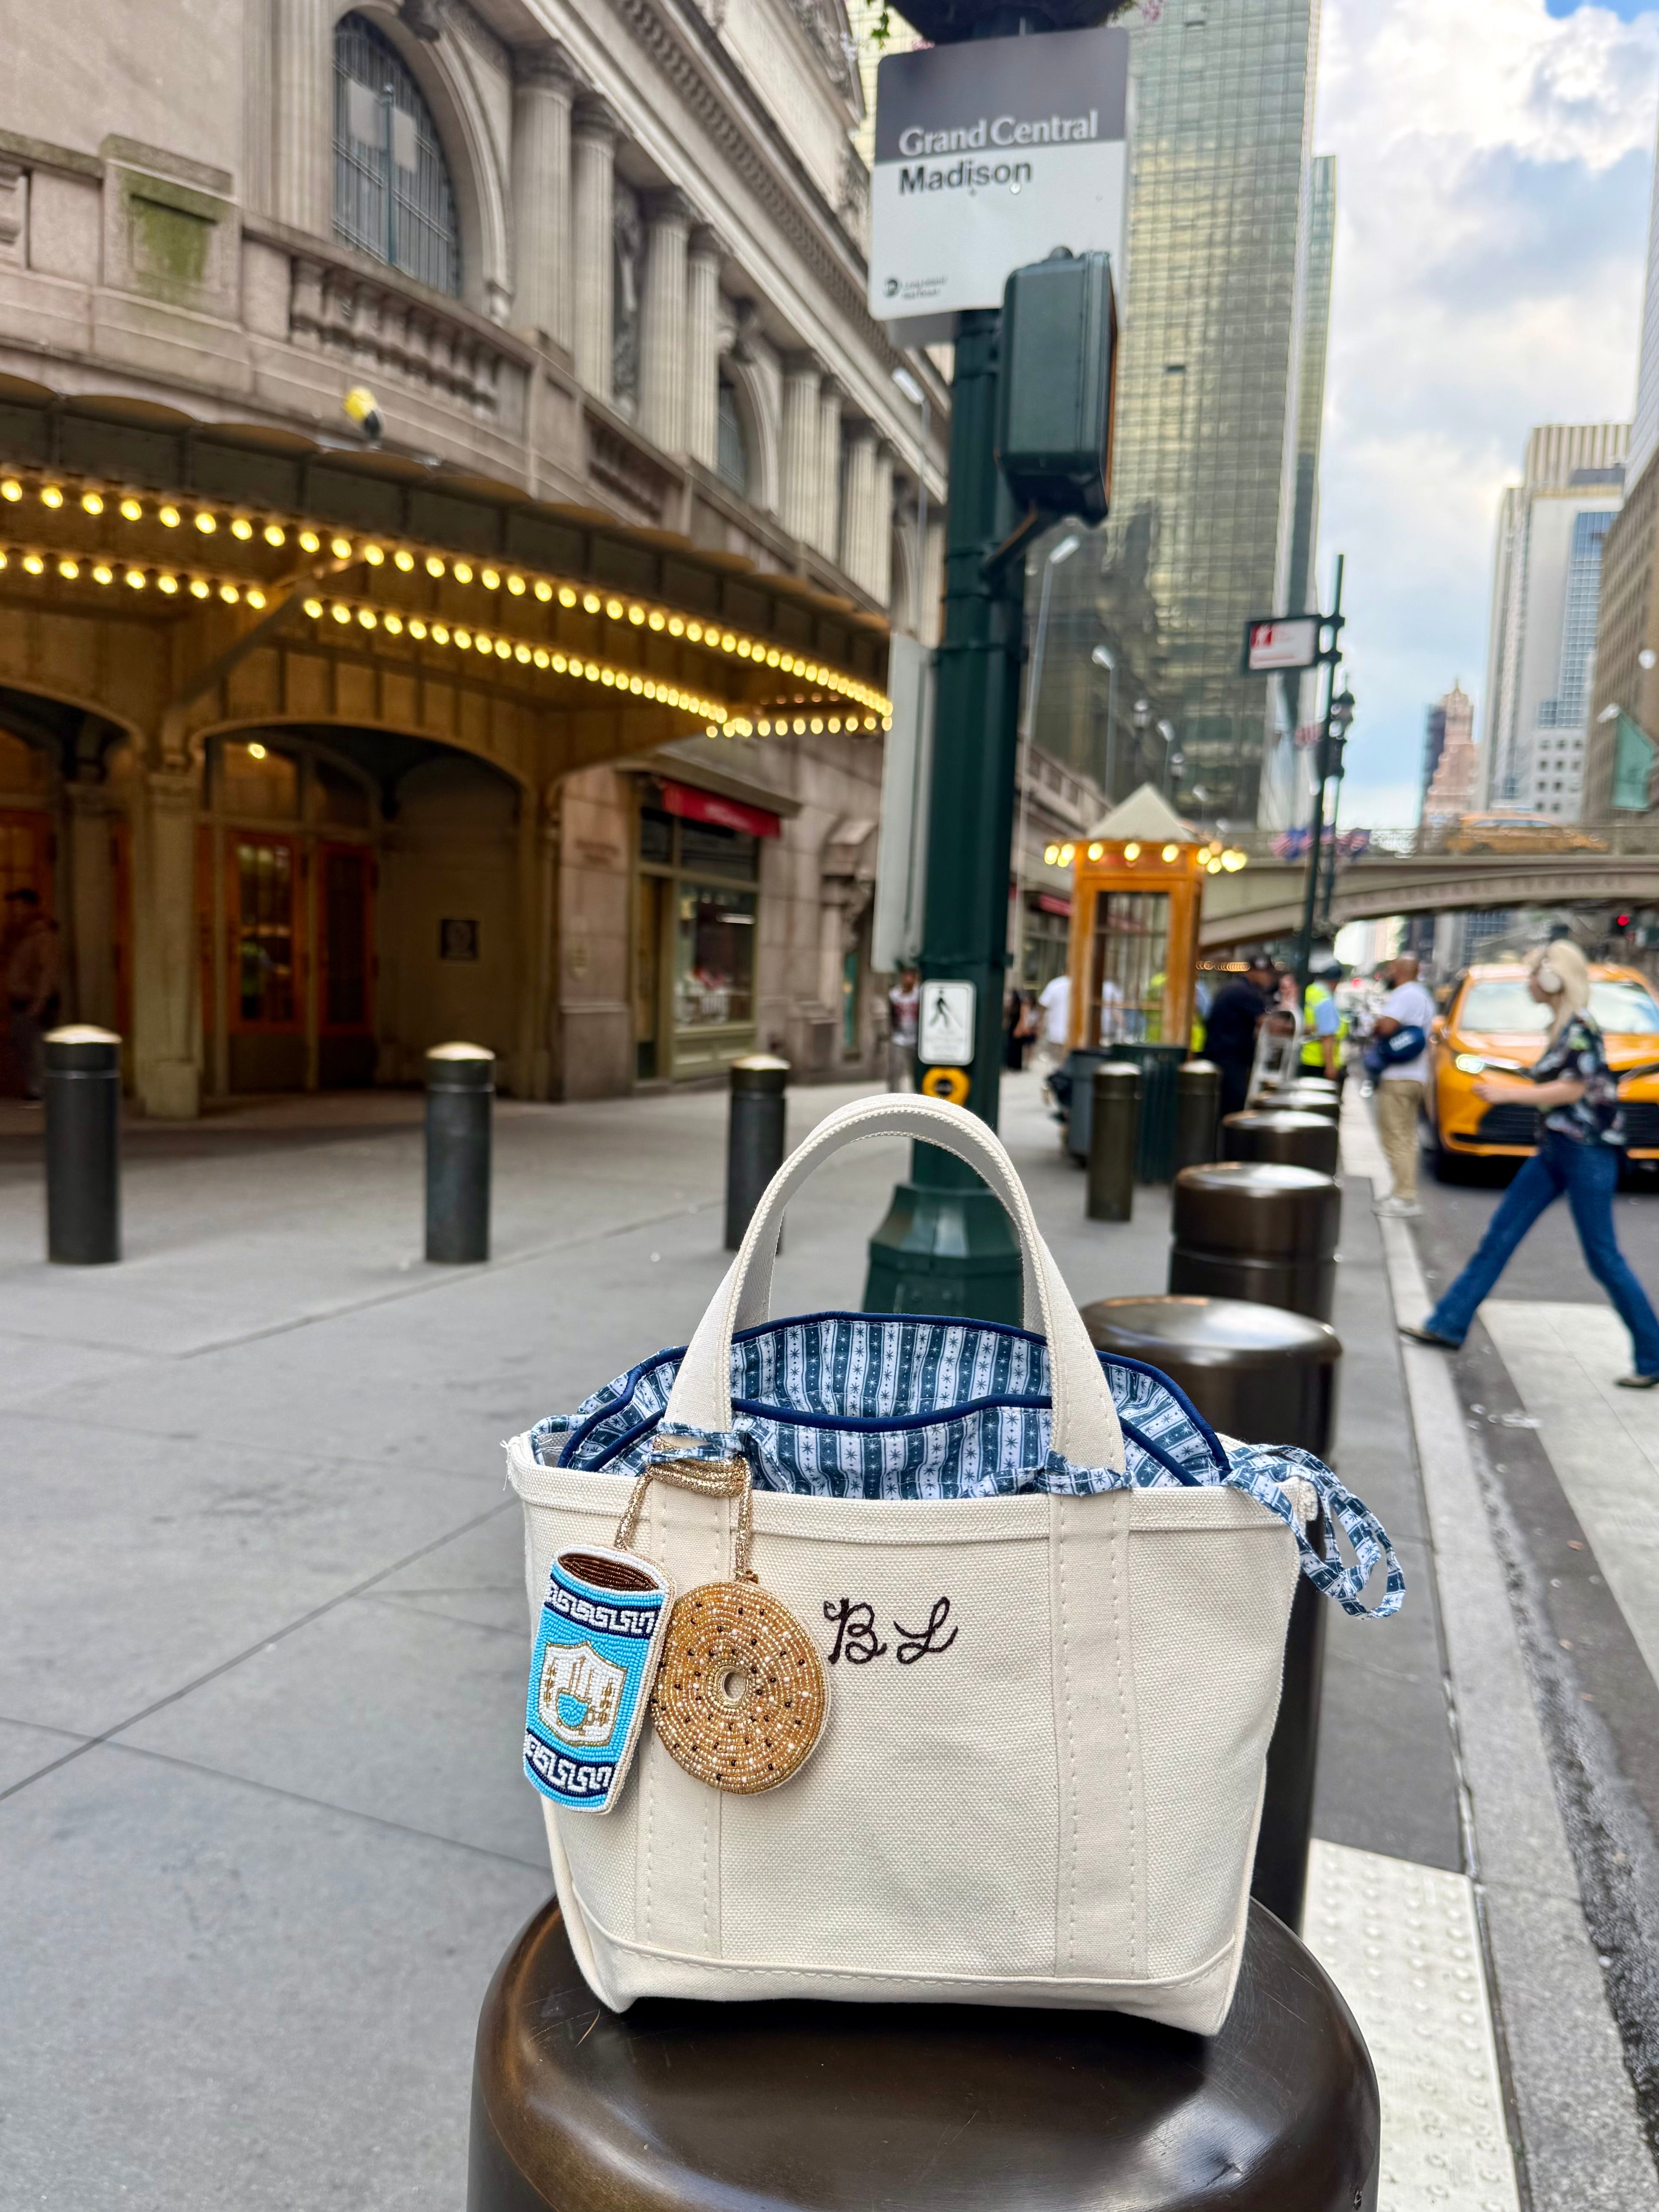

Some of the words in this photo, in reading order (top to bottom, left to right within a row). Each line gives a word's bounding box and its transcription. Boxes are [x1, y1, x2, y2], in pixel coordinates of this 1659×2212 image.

[899, 119, 987, 156] Grand
[991, 109, 1098, 145] Central
[900, 160, 1032, 194] Madison
